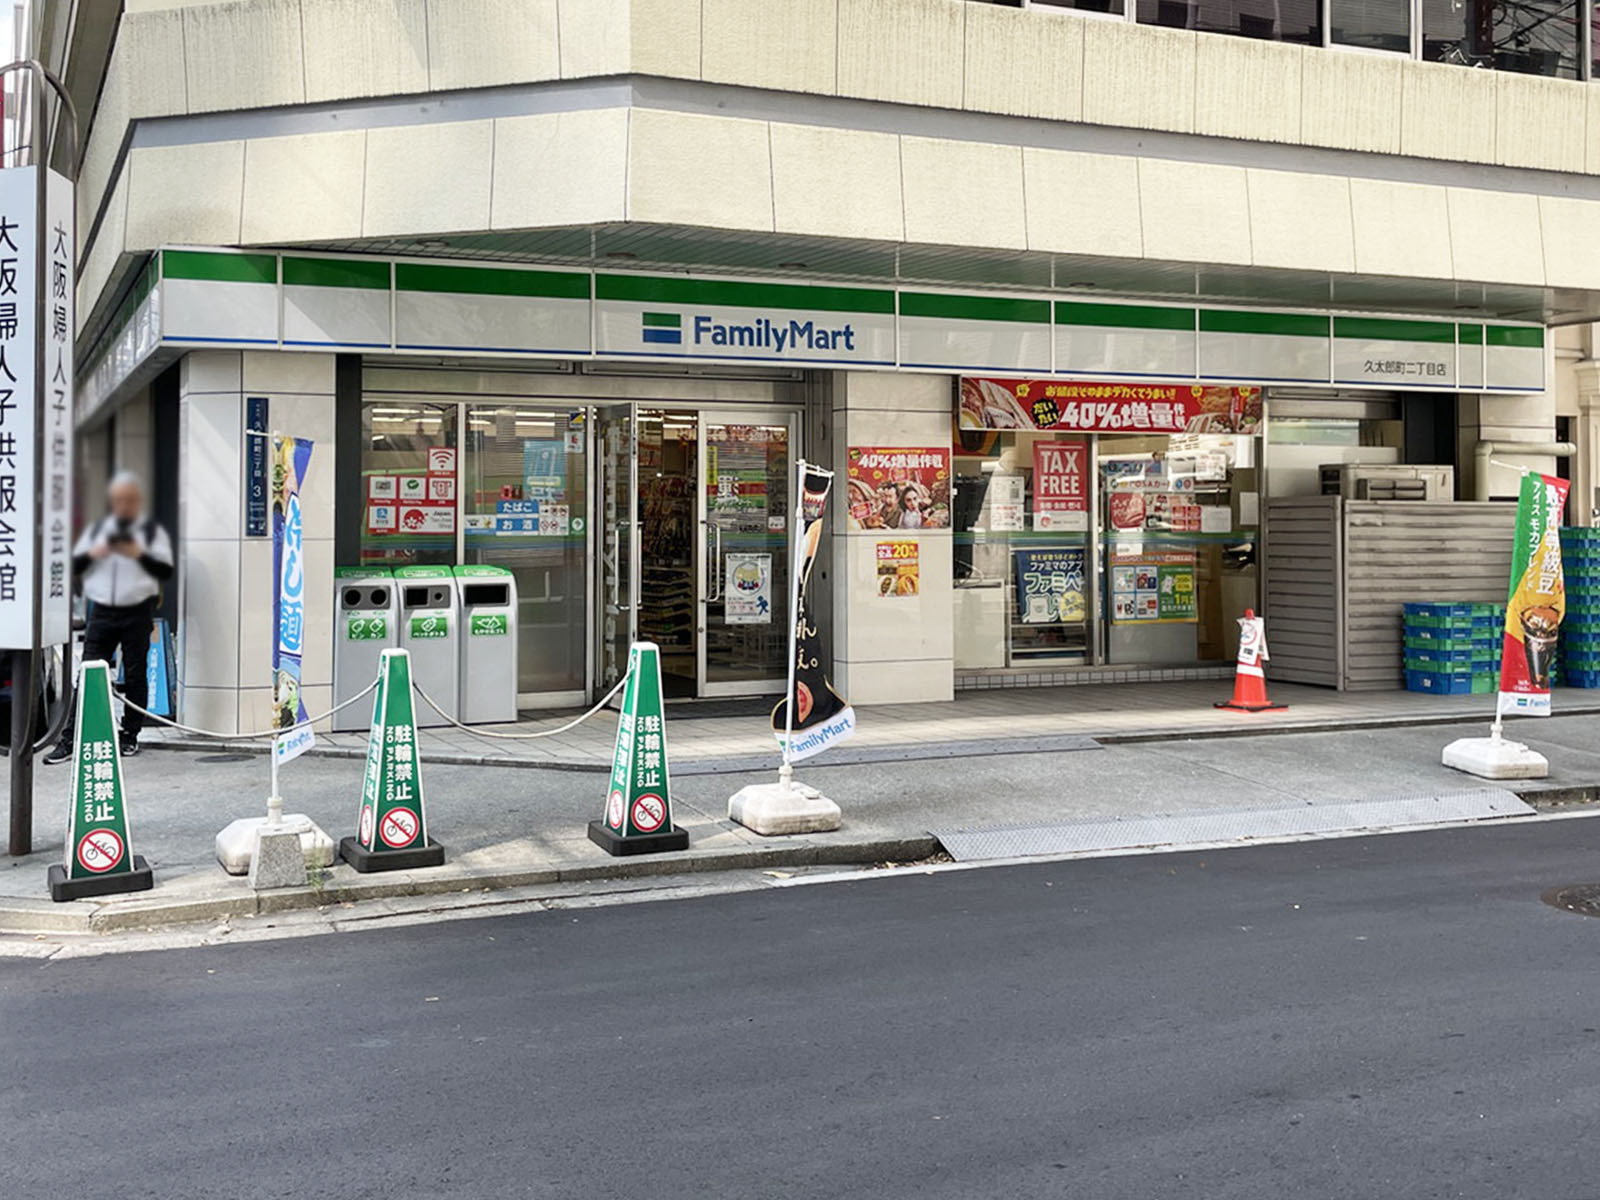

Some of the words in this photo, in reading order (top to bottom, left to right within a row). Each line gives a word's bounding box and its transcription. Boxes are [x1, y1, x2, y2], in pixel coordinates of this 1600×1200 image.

[694, 315, 855, 352] FamilyMart
[1363, 359, 1447, 376] 久太郎町二丁目店
[1059, 401, 1174, 429] 40%増量
[1040, 451, 1079, 474] TAX
[253, 486, 262, 498] 3
[1040, 475, 1080, 495] FREE
[502, 502, 533, 513] たばこ
[892, 544, 909, 558] 20
[386, 725, 394, 743] NO
[637, 716, 644, 733] NO
[82, 742, 92, 761] NO
[394, 724, 413, 801] 駐輪禁止
[636, 736, 645, 788] PARKING
[644, 714, 661, 788] 駐輪禁止
[93, 740, 116, 822] 駐輪禁止
[386, 747, 395, 801] PARKING
[83, 764, 94, 823] PARKING
